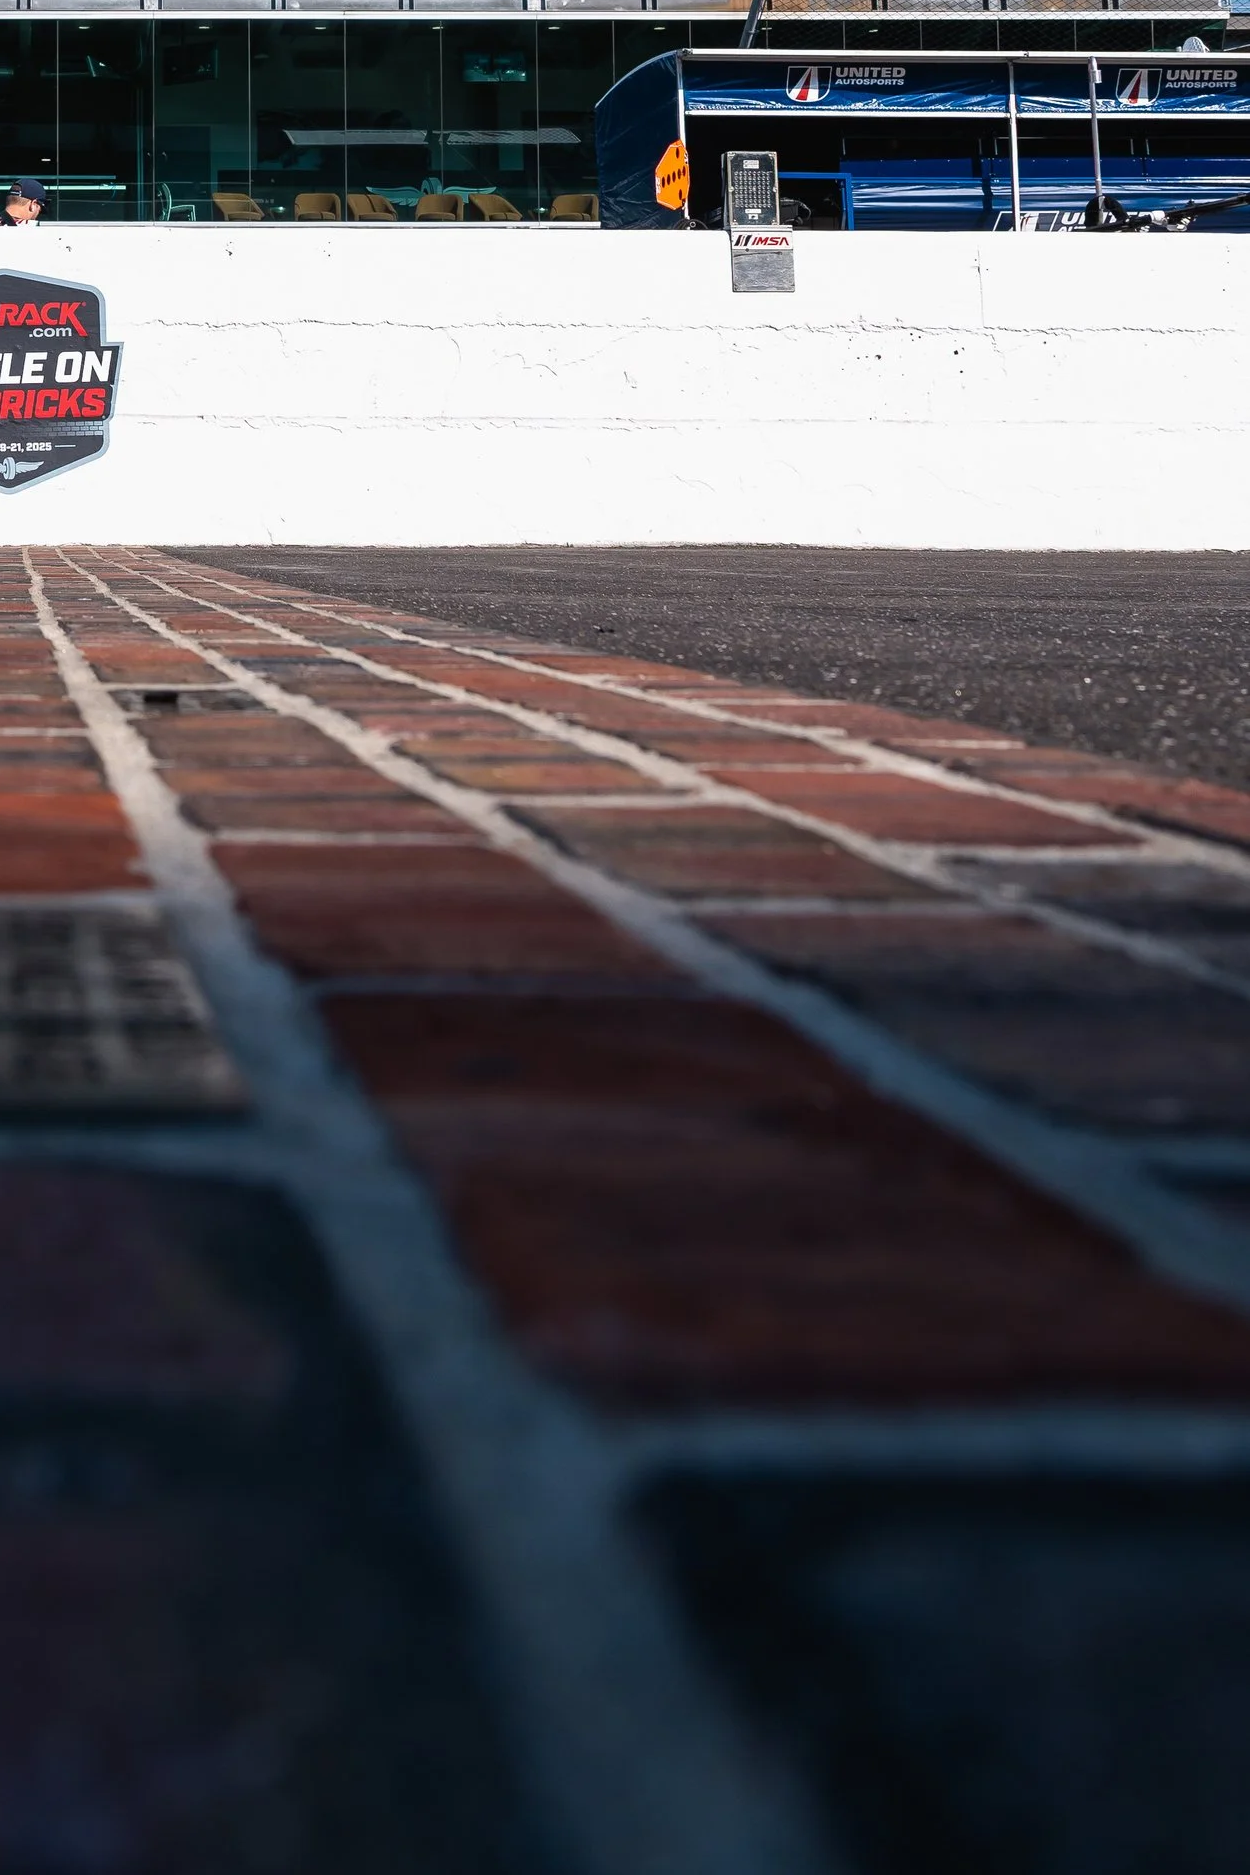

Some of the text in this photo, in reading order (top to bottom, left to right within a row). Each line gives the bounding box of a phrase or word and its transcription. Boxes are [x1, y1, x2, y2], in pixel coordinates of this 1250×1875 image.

[835, 67, 906, 78] UNITED
[1166, 69, 1238, 80] UNITED
[835, 78, 905, 86] AUTOSPORTS
[1165, 81, 1237, 89] AUTOSPORTS
[751, 236, 790, 246] IMSA
[28, 326, 73, 338] .com
[54, 349, 113, 383] ON
[26, 441, 52, 452] 2025
